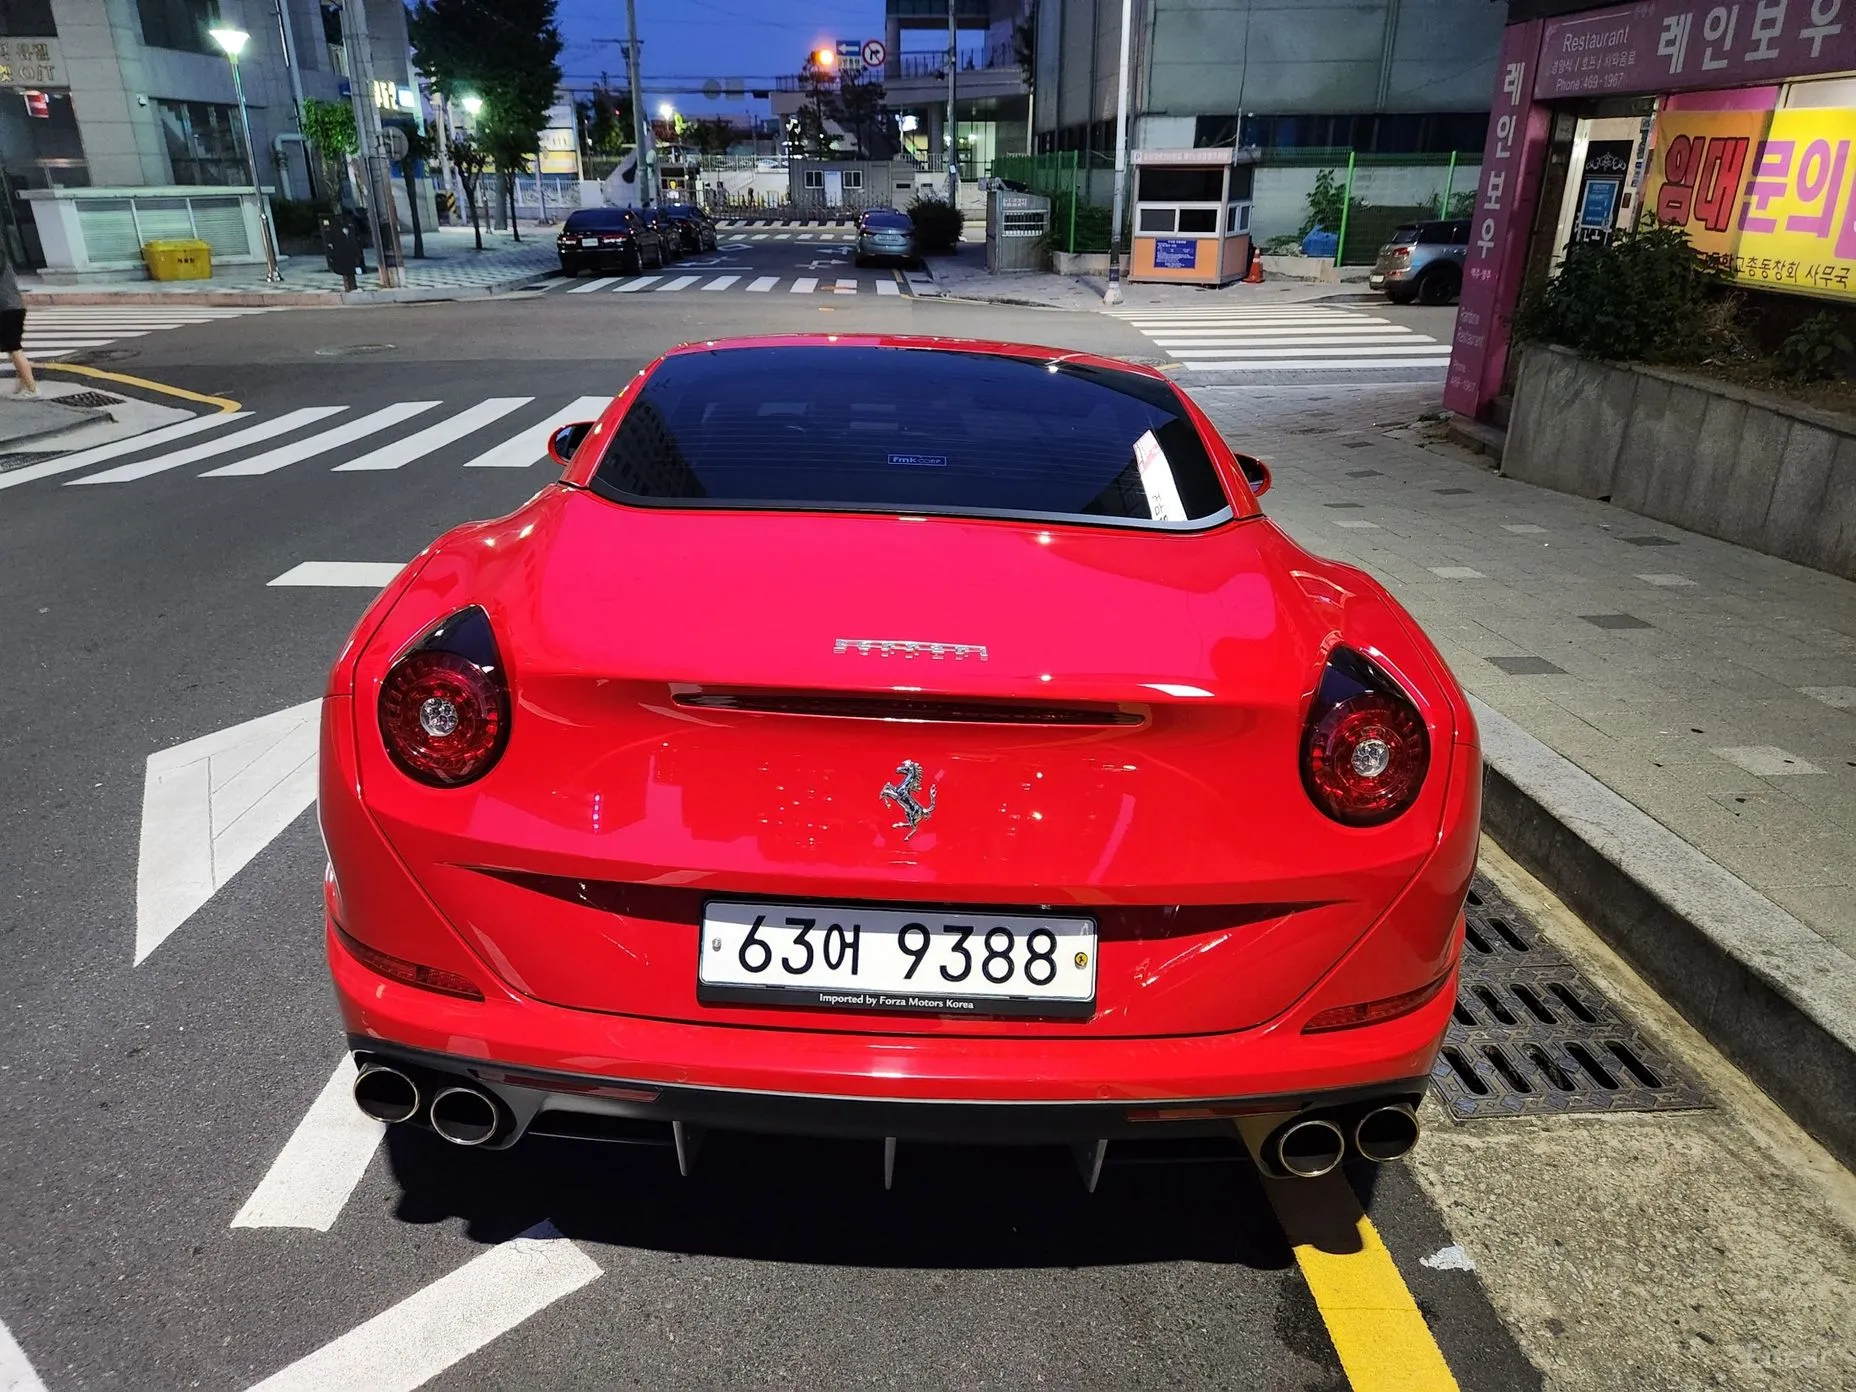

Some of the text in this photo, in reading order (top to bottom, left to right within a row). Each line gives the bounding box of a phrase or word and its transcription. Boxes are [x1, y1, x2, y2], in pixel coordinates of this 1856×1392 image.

[1562, 25, 1630, 52] Restaurant
[1657, 0, 1842, 74] 레인보우
[1477, 62, 1526, 259] 레인보우
[1657, 134, 1851, 239] 임대 문의
[1805, 263, 1851, 289] 사무국
[738, 915, 1058, 986] 63어 9388
[819, 993, 974, 1009] Imported by Forza Motors Korea
